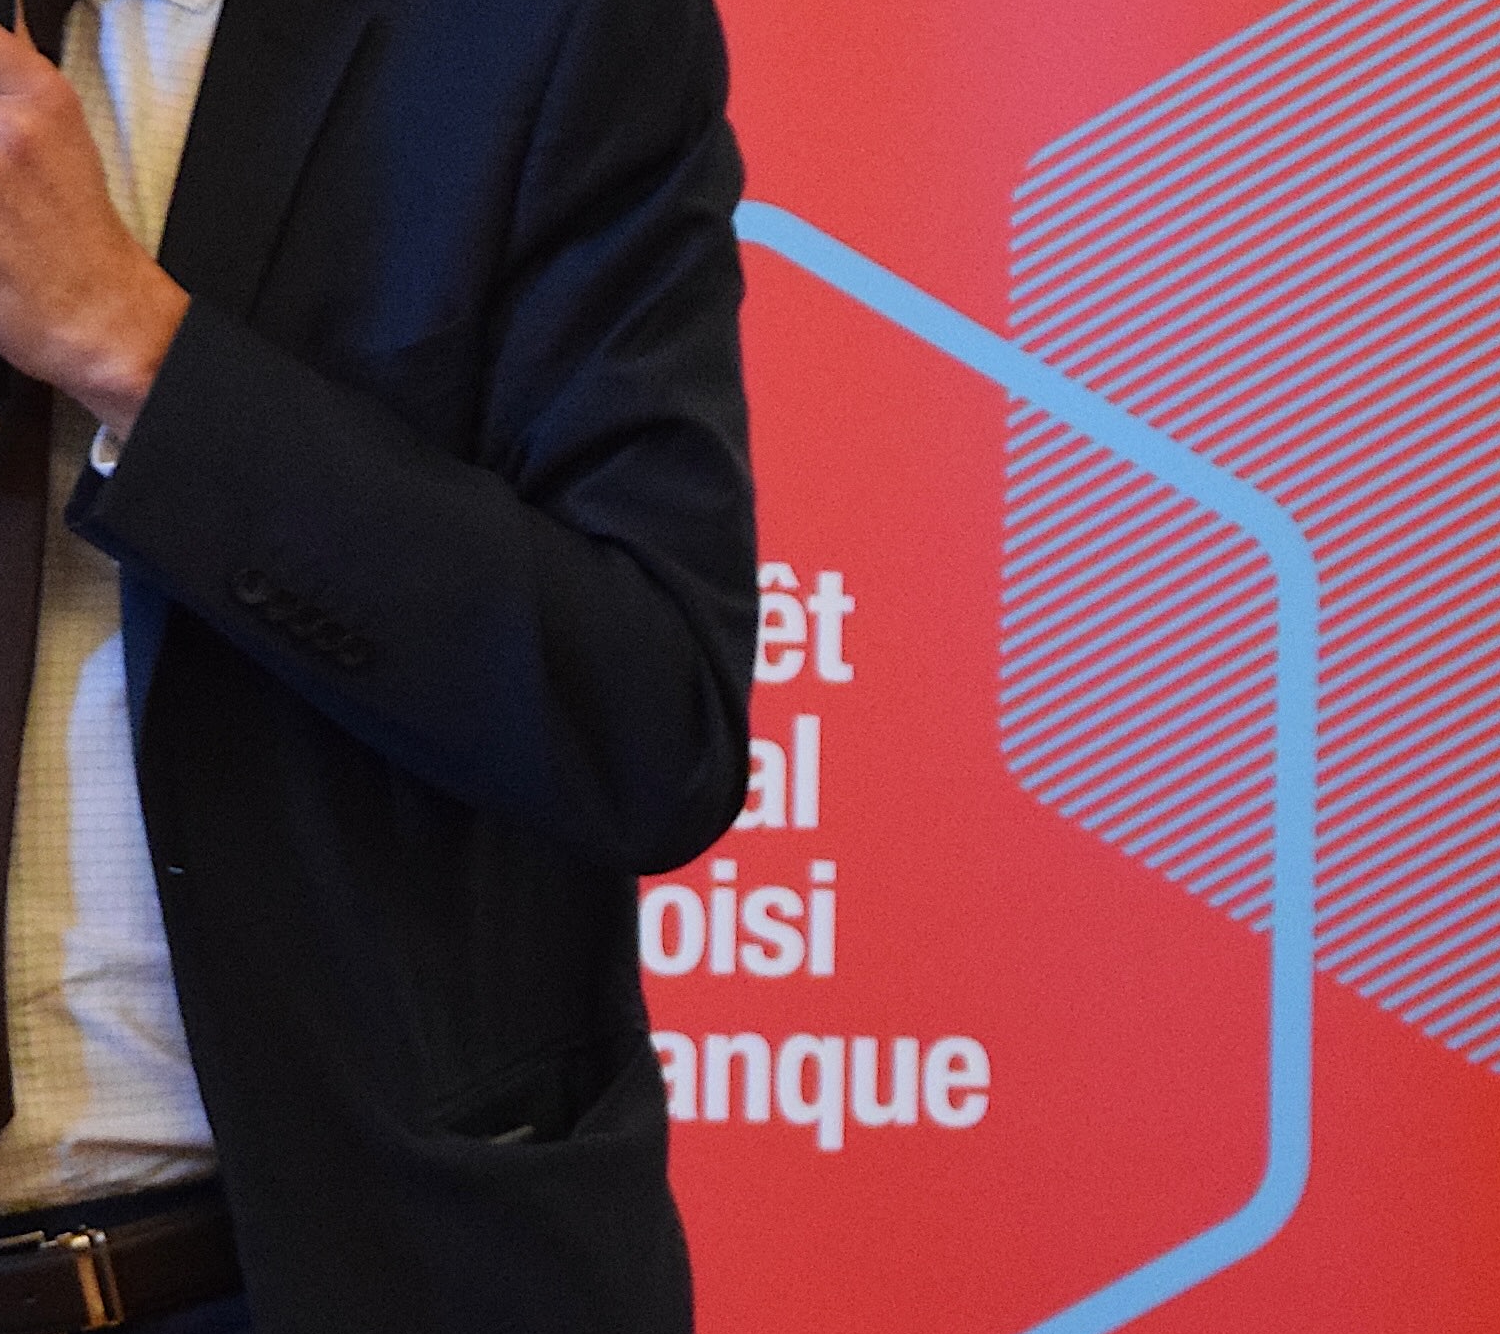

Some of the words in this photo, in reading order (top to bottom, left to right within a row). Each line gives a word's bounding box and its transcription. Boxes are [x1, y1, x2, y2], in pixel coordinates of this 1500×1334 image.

[753, 561, 855, 683] êt
[731, 714, 821, 829] al
[638, 859, 837, 977] oisi
[650, 1031, 992, 1151] anque
